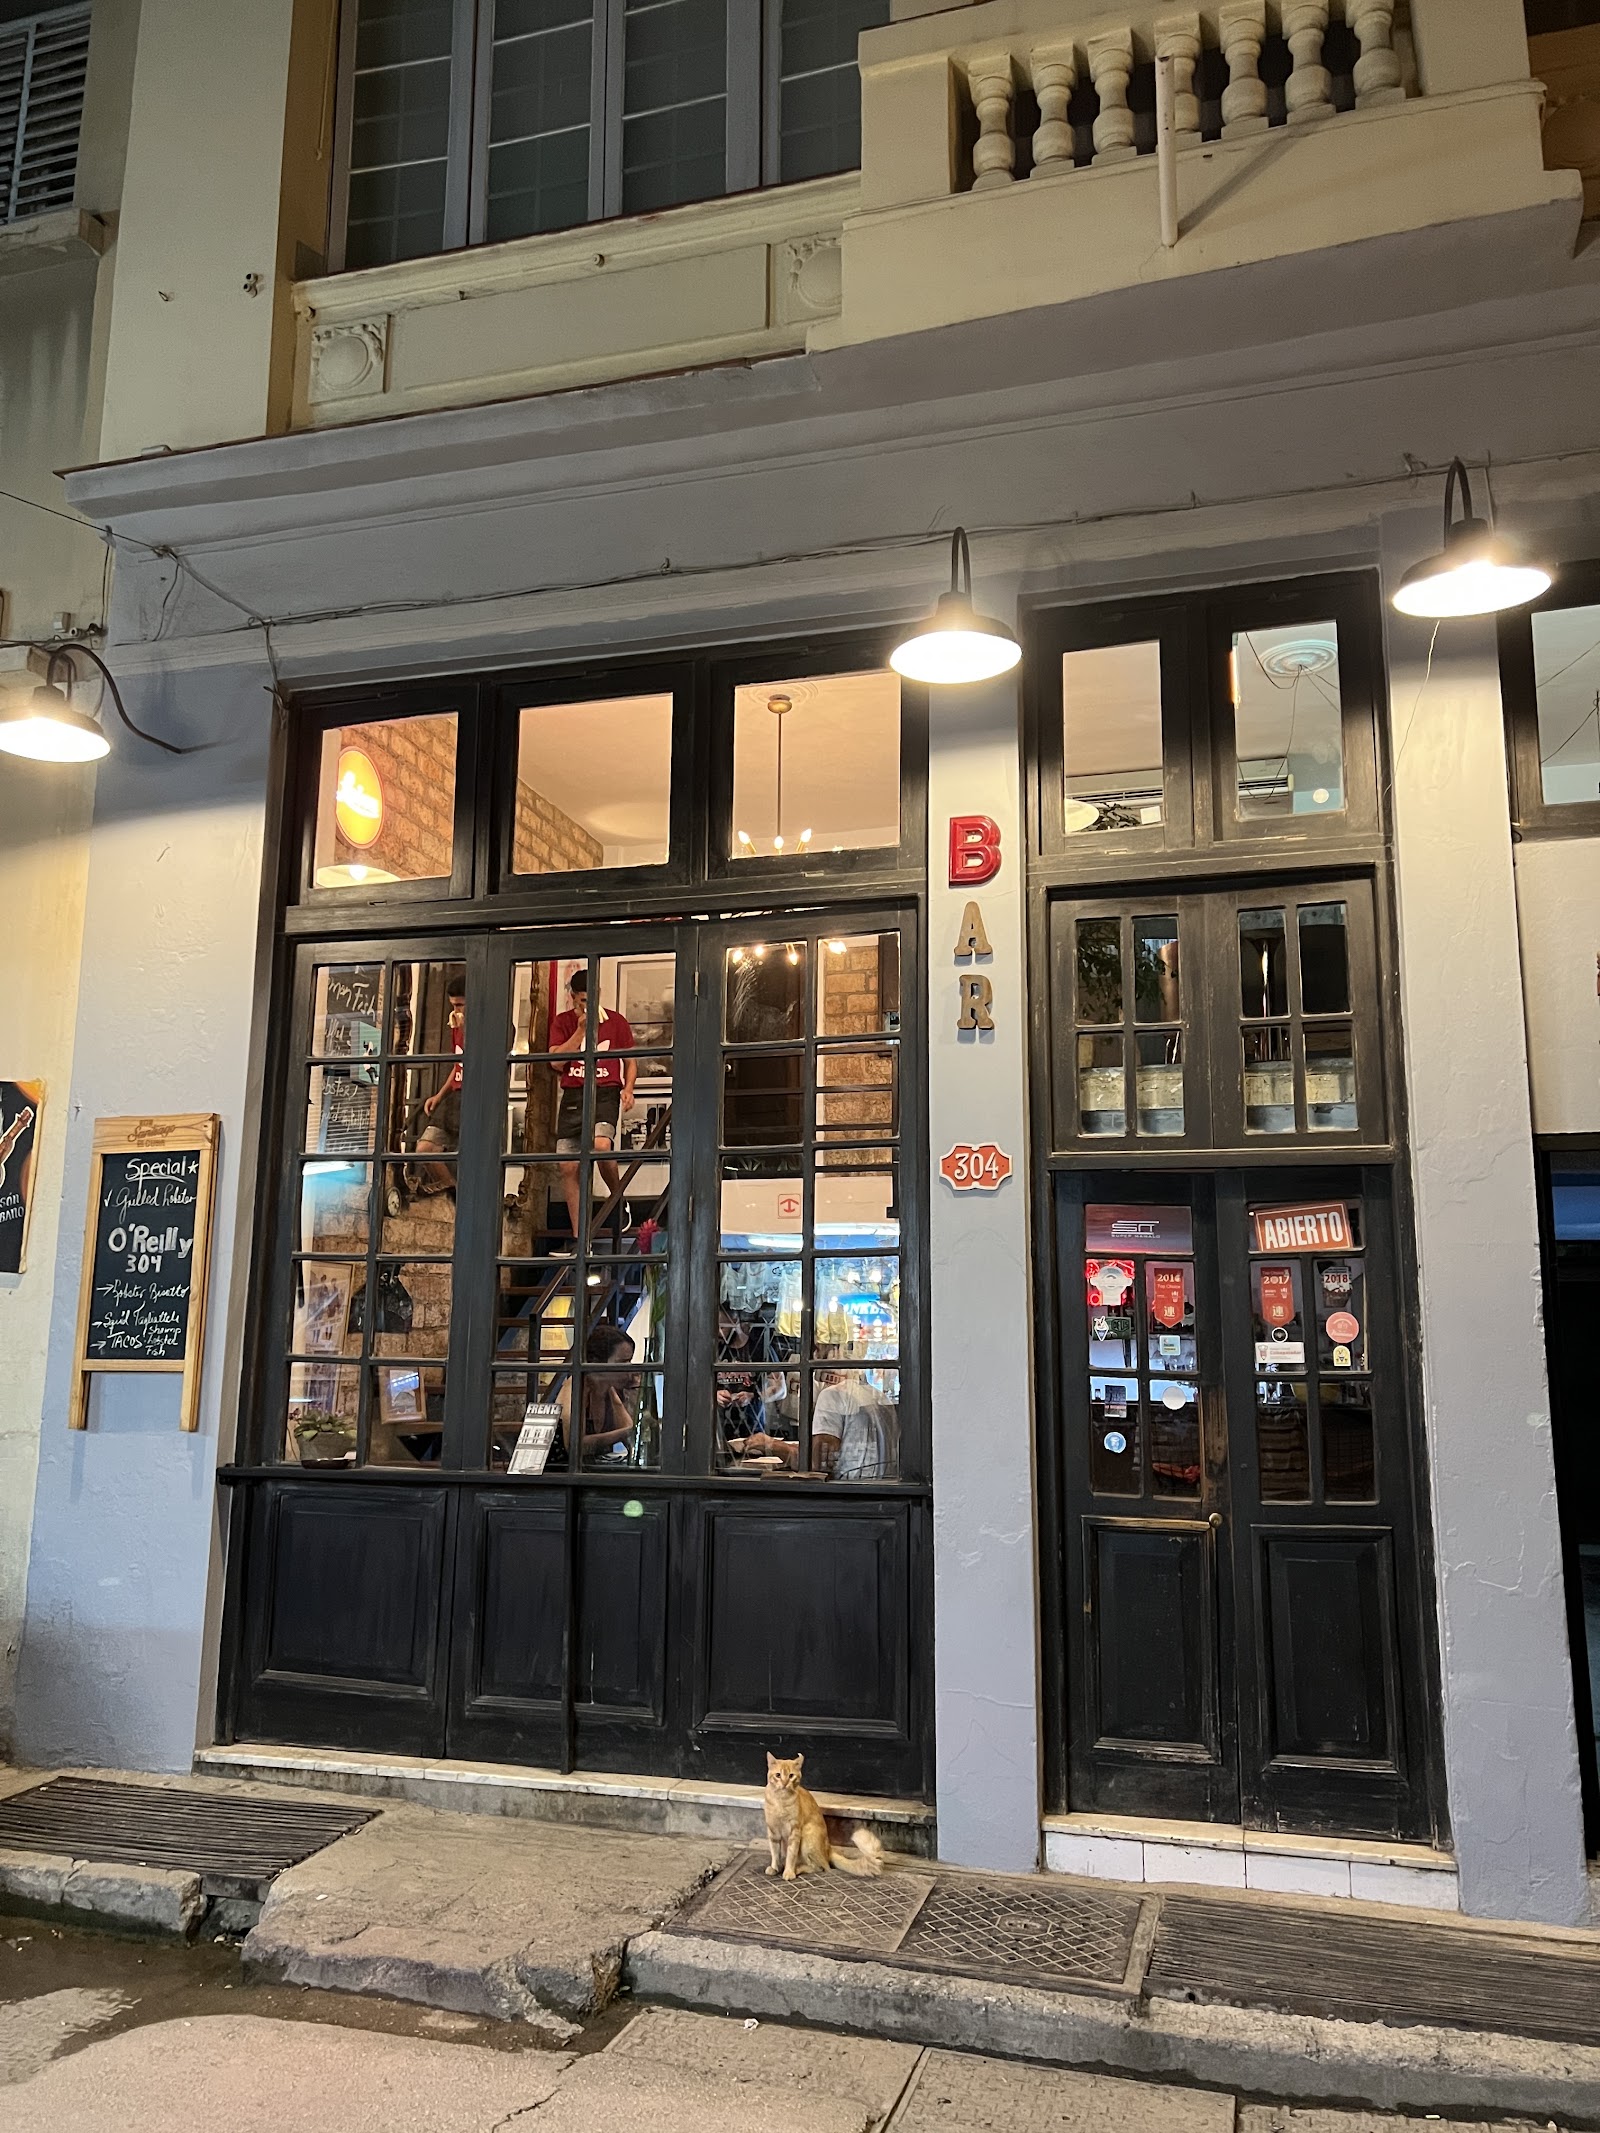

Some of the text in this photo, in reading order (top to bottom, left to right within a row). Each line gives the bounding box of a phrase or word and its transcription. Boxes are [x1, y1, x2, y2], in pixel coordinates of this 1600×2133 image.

[948, 815, 1002, 1030] BAR
[125, 1156, 186, 1192] Special
[954, 1152, 999, 1180] 304
[108, 1223, 194, 1259] O'Reilly
[1264, 1211, 1344, 1250] ABIERTO
[125, 1254, 162, 1274] 304
[1157, 1273, 1181, 1282] 2016
[1262, 1275, 1290, 1284] 2017
[1324, 1274, 1349, 1284] 2018
[107, 1331, 143, 1349] TACOS
